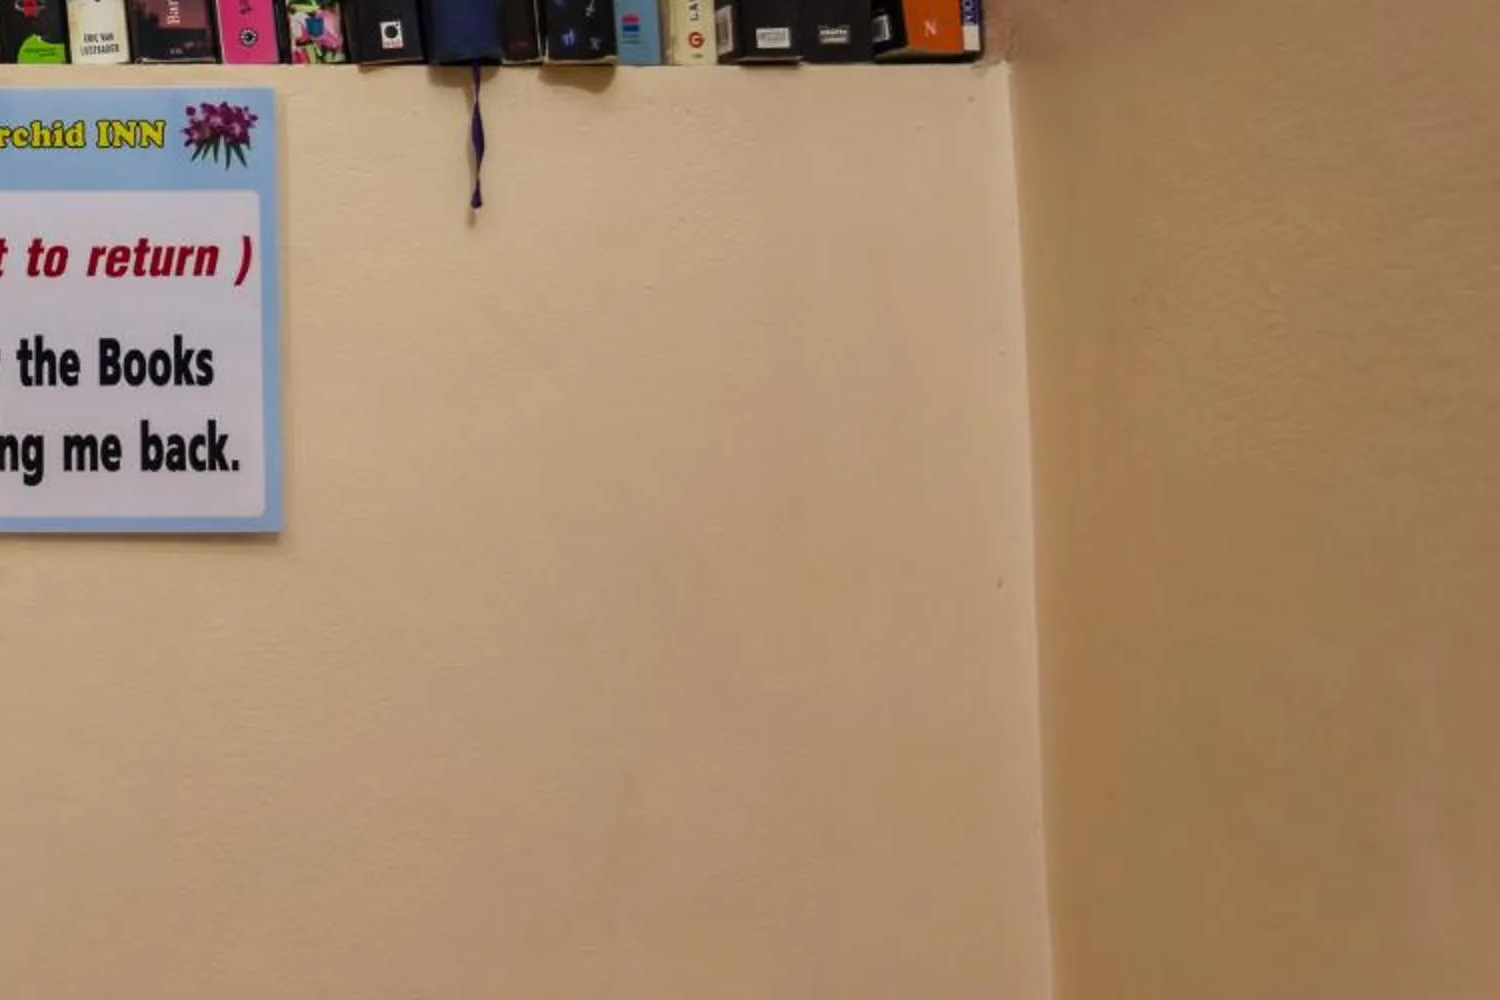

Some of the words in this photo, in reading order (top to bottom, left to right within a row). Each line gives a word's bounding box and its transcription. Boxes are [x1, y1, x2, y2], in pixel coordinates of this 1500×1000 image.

[96, 120, 166, 149] INN
[25, 237, 70, 278] to
[86, 237, 218, 278] return
[16, 335, 80, 387] the
[99, 335, 214, 387] Books
[63, 431, 123, 473] me
[140, 420, 240, 473] back.
